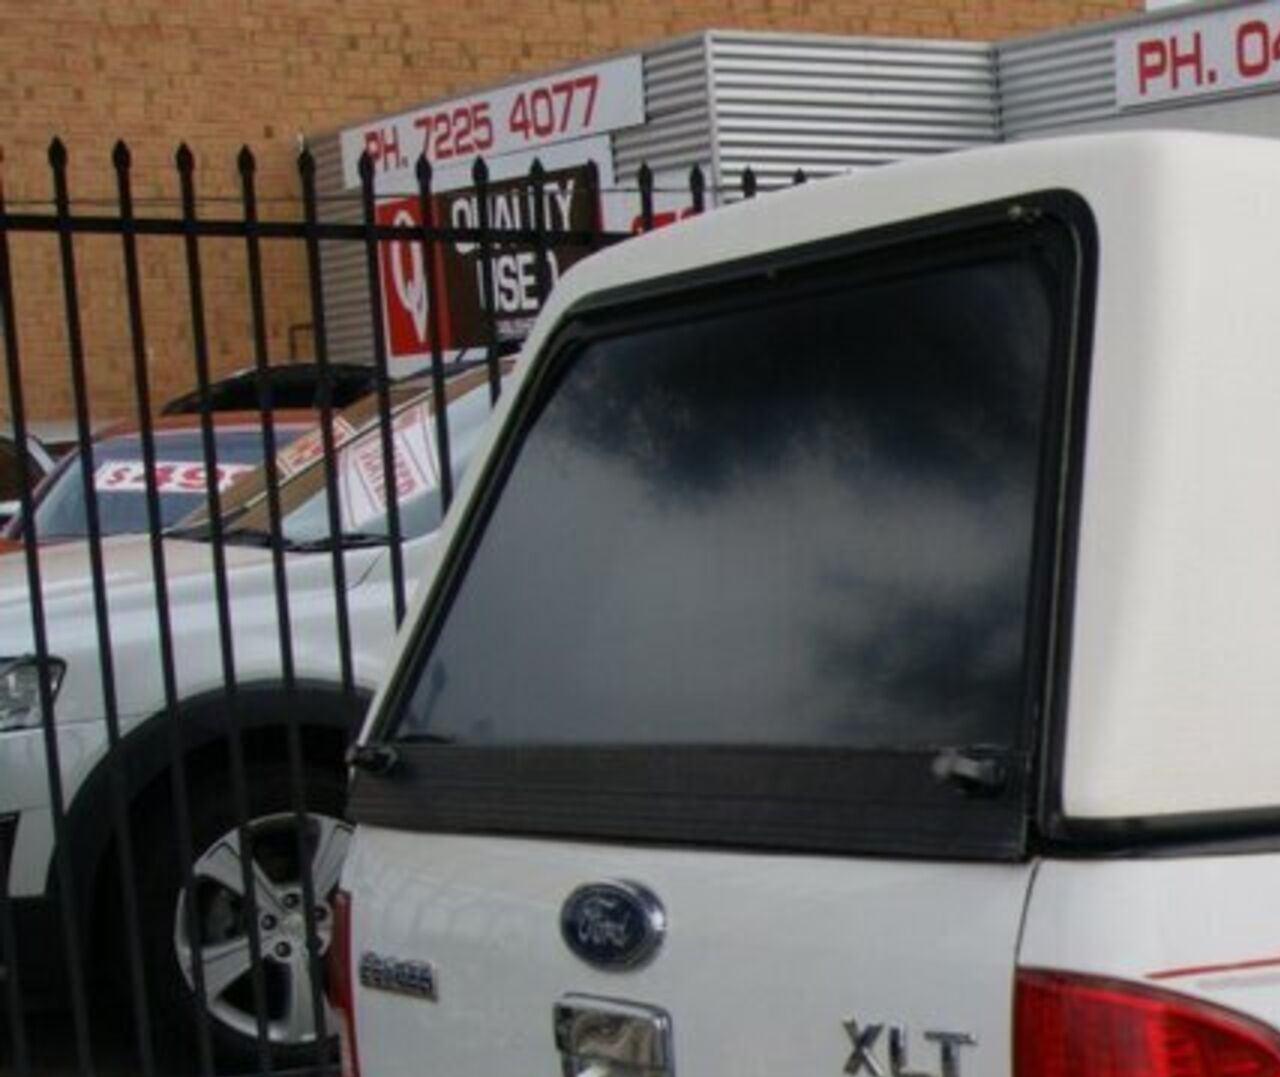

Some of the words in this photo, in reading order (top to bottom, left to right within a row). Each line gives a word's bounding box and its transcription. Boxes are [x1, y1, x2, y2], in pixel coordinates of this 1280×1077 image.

[1138, 32, 1217, 95] PH.
[414, 103, 494, 161] 7225
[509, 73, 599, 141] 4077
